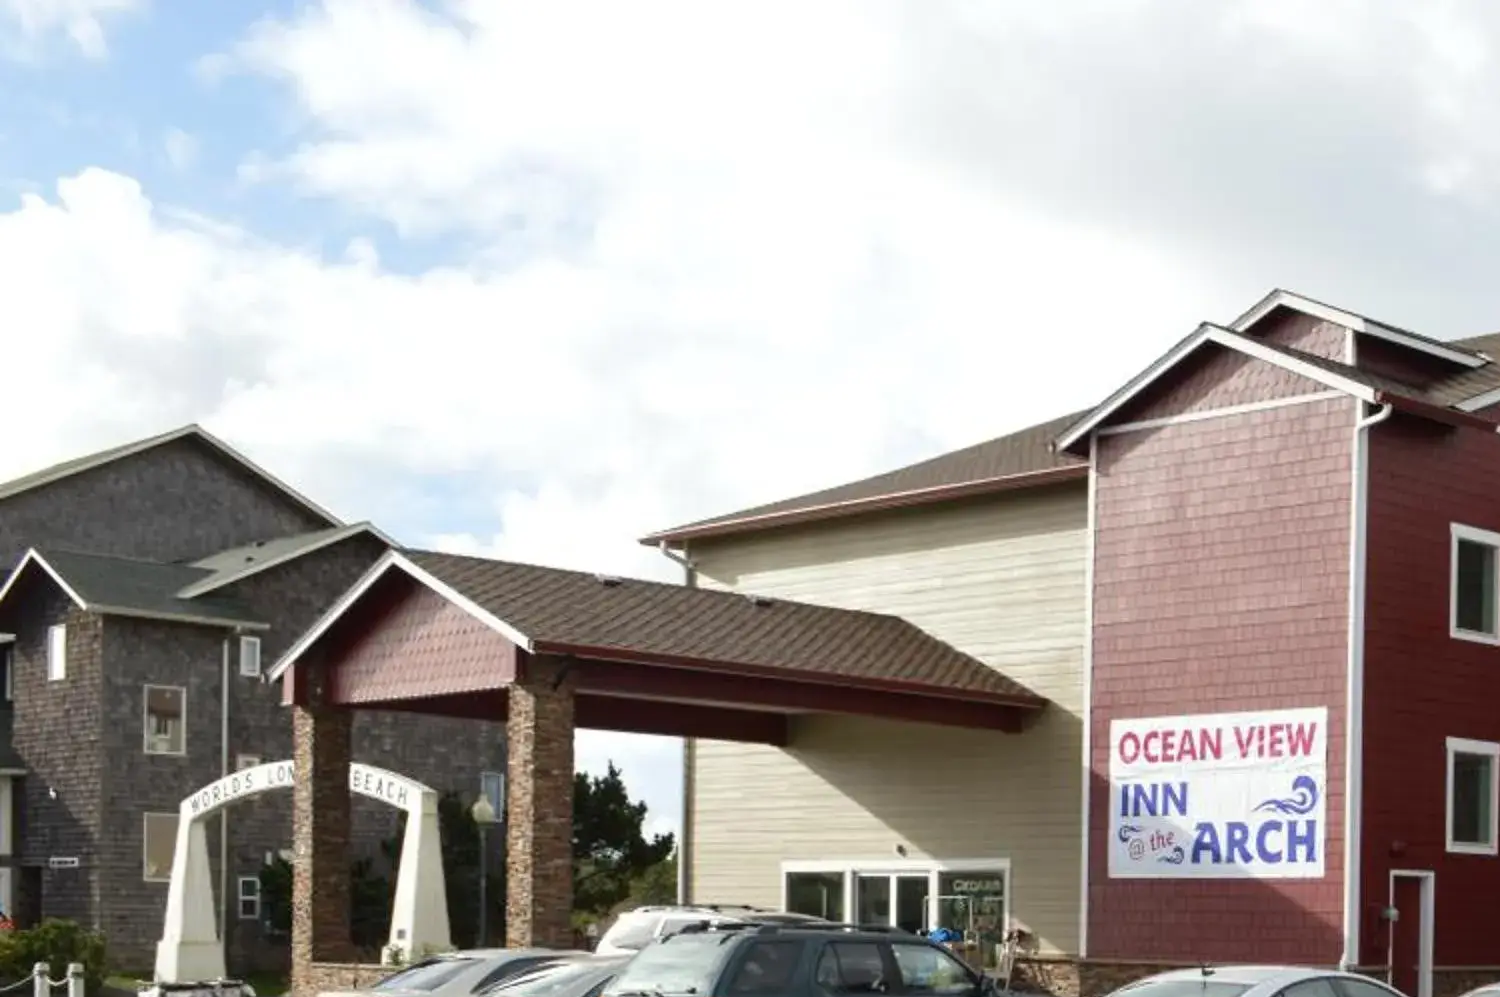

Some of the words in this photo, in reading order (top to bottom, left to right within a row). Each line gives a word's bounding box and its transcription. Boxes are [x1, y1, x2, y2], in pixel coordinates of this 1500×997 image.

[1118, 728, 1222, 764] OCEAN
[1233, 722, 1317, 759] VIEW
[190, 772, 253, 813] WORLDS
[353, 769, 408, 805] BEACH
[1120, 782, 1188, 817] INN
[1149, 829, 1175, 851] the
[1191, 820, 1317, 864] ARCH
